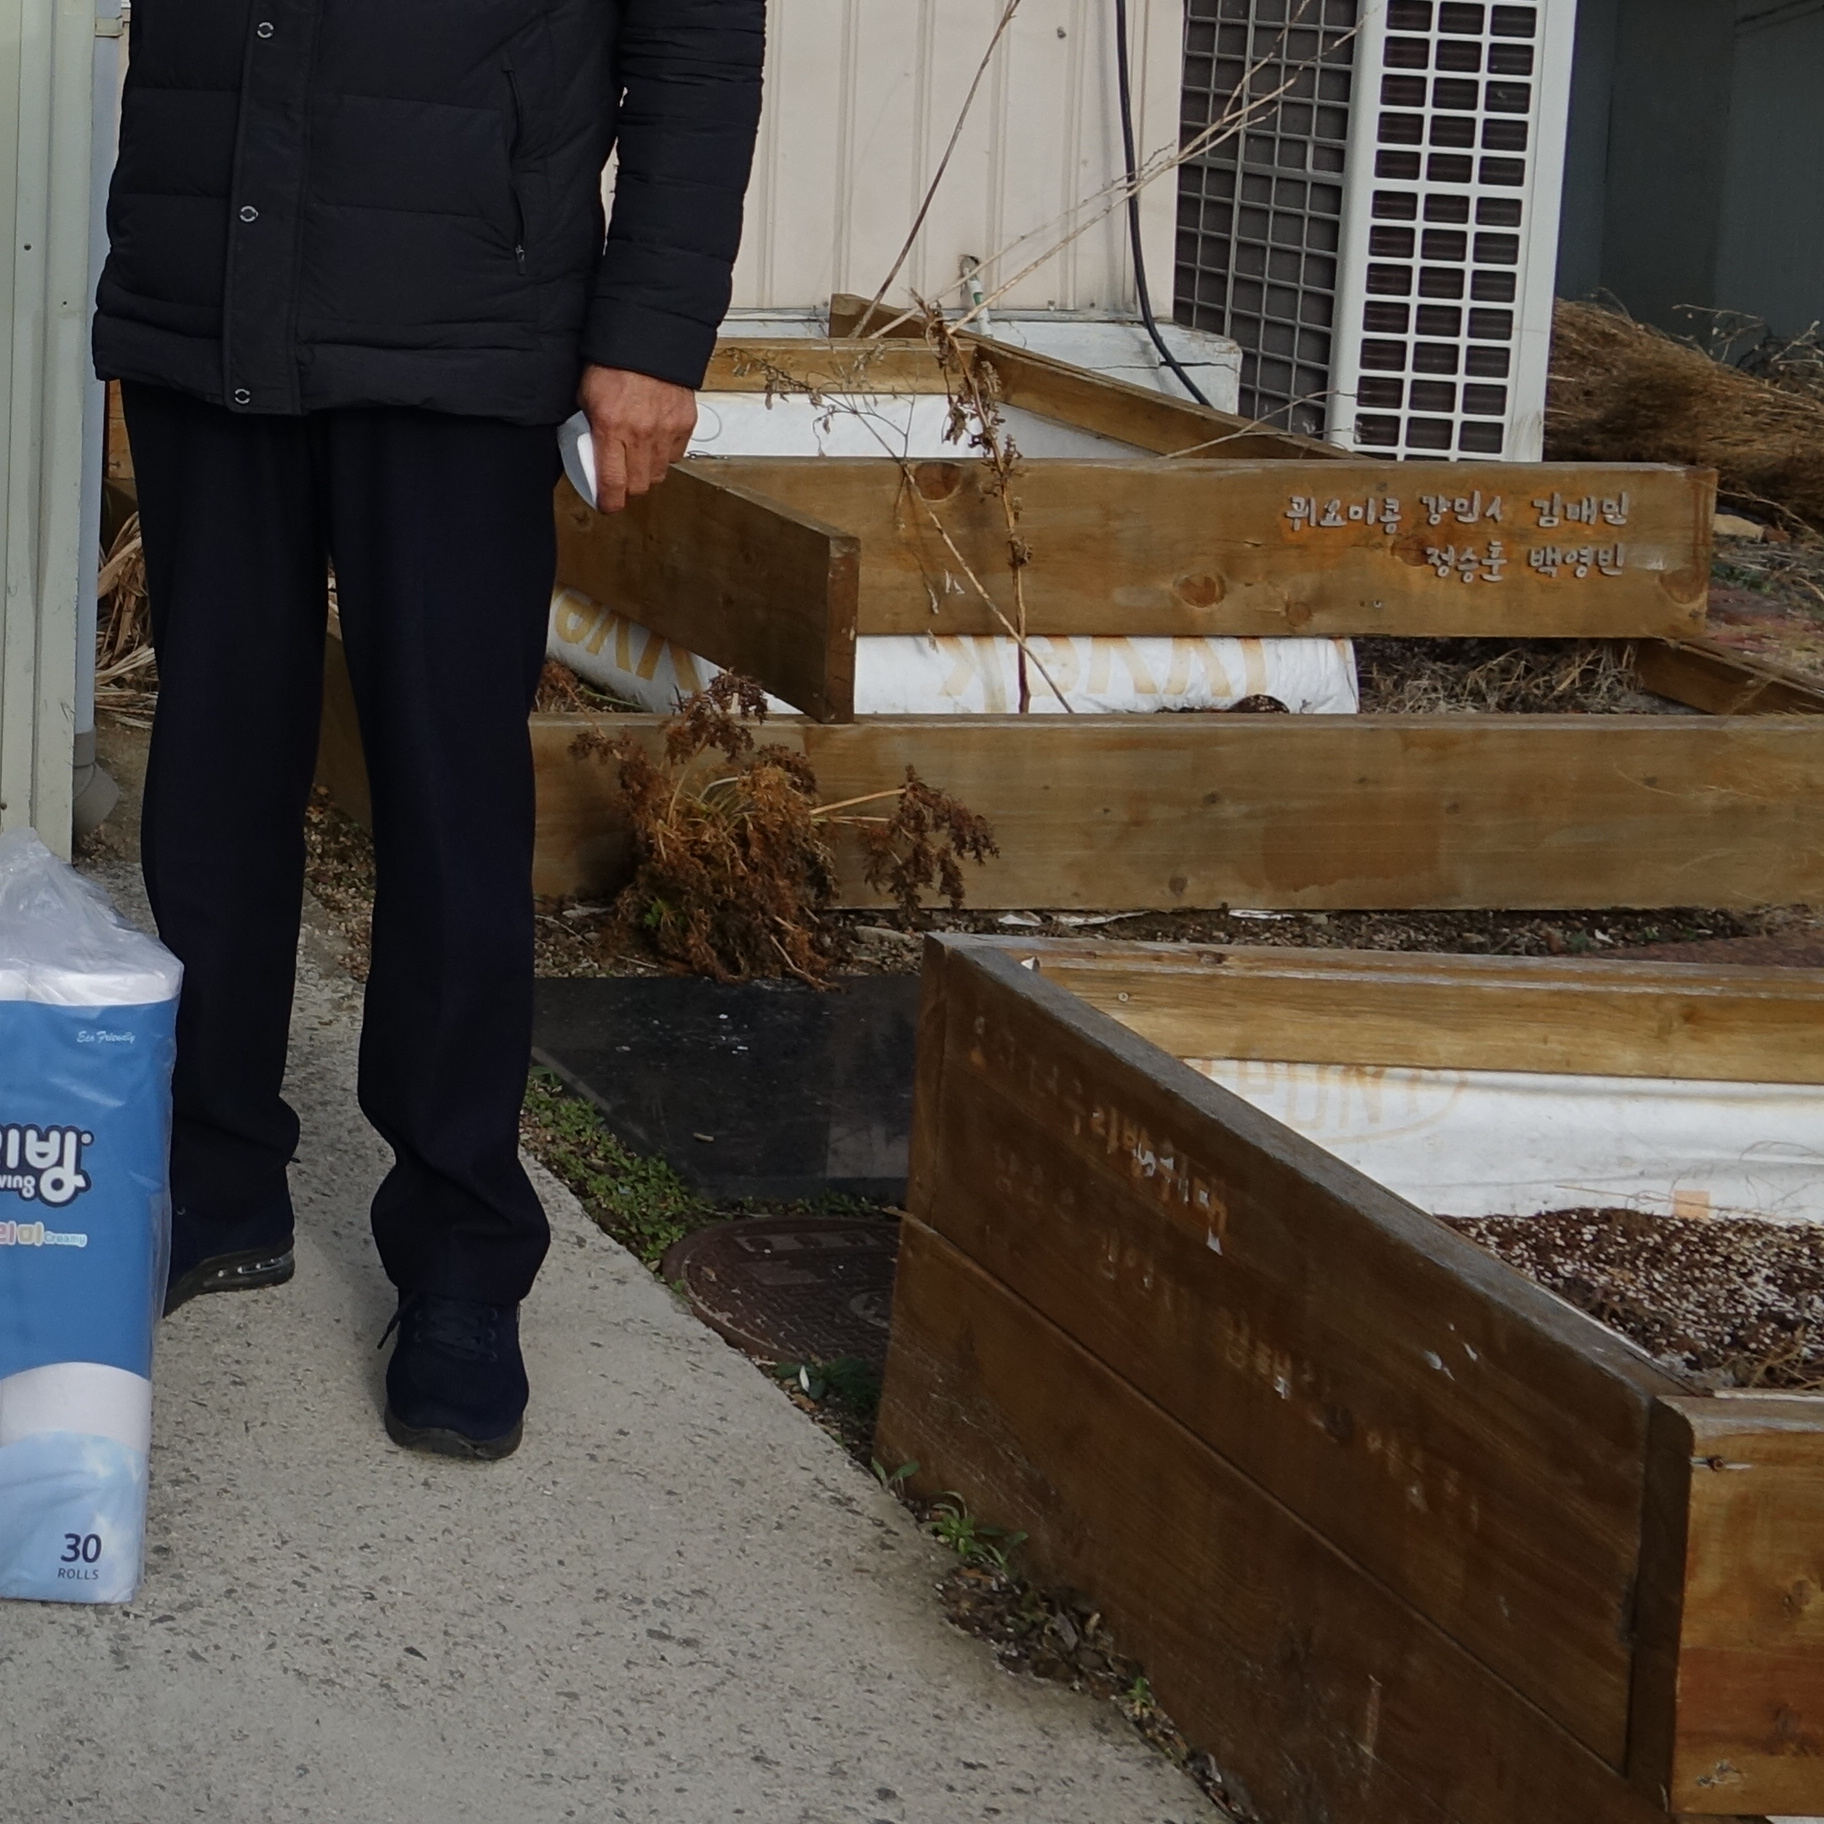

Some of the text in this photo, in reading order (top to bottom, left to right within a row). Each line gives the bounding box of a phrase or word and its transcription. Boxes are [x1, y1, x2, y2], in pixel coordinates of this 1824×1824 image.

[44, 1231, 87, 1247] Creamy
[59, 1532, 102, 1564] 30
[57, 1567, 100, 1581] ROLLS
